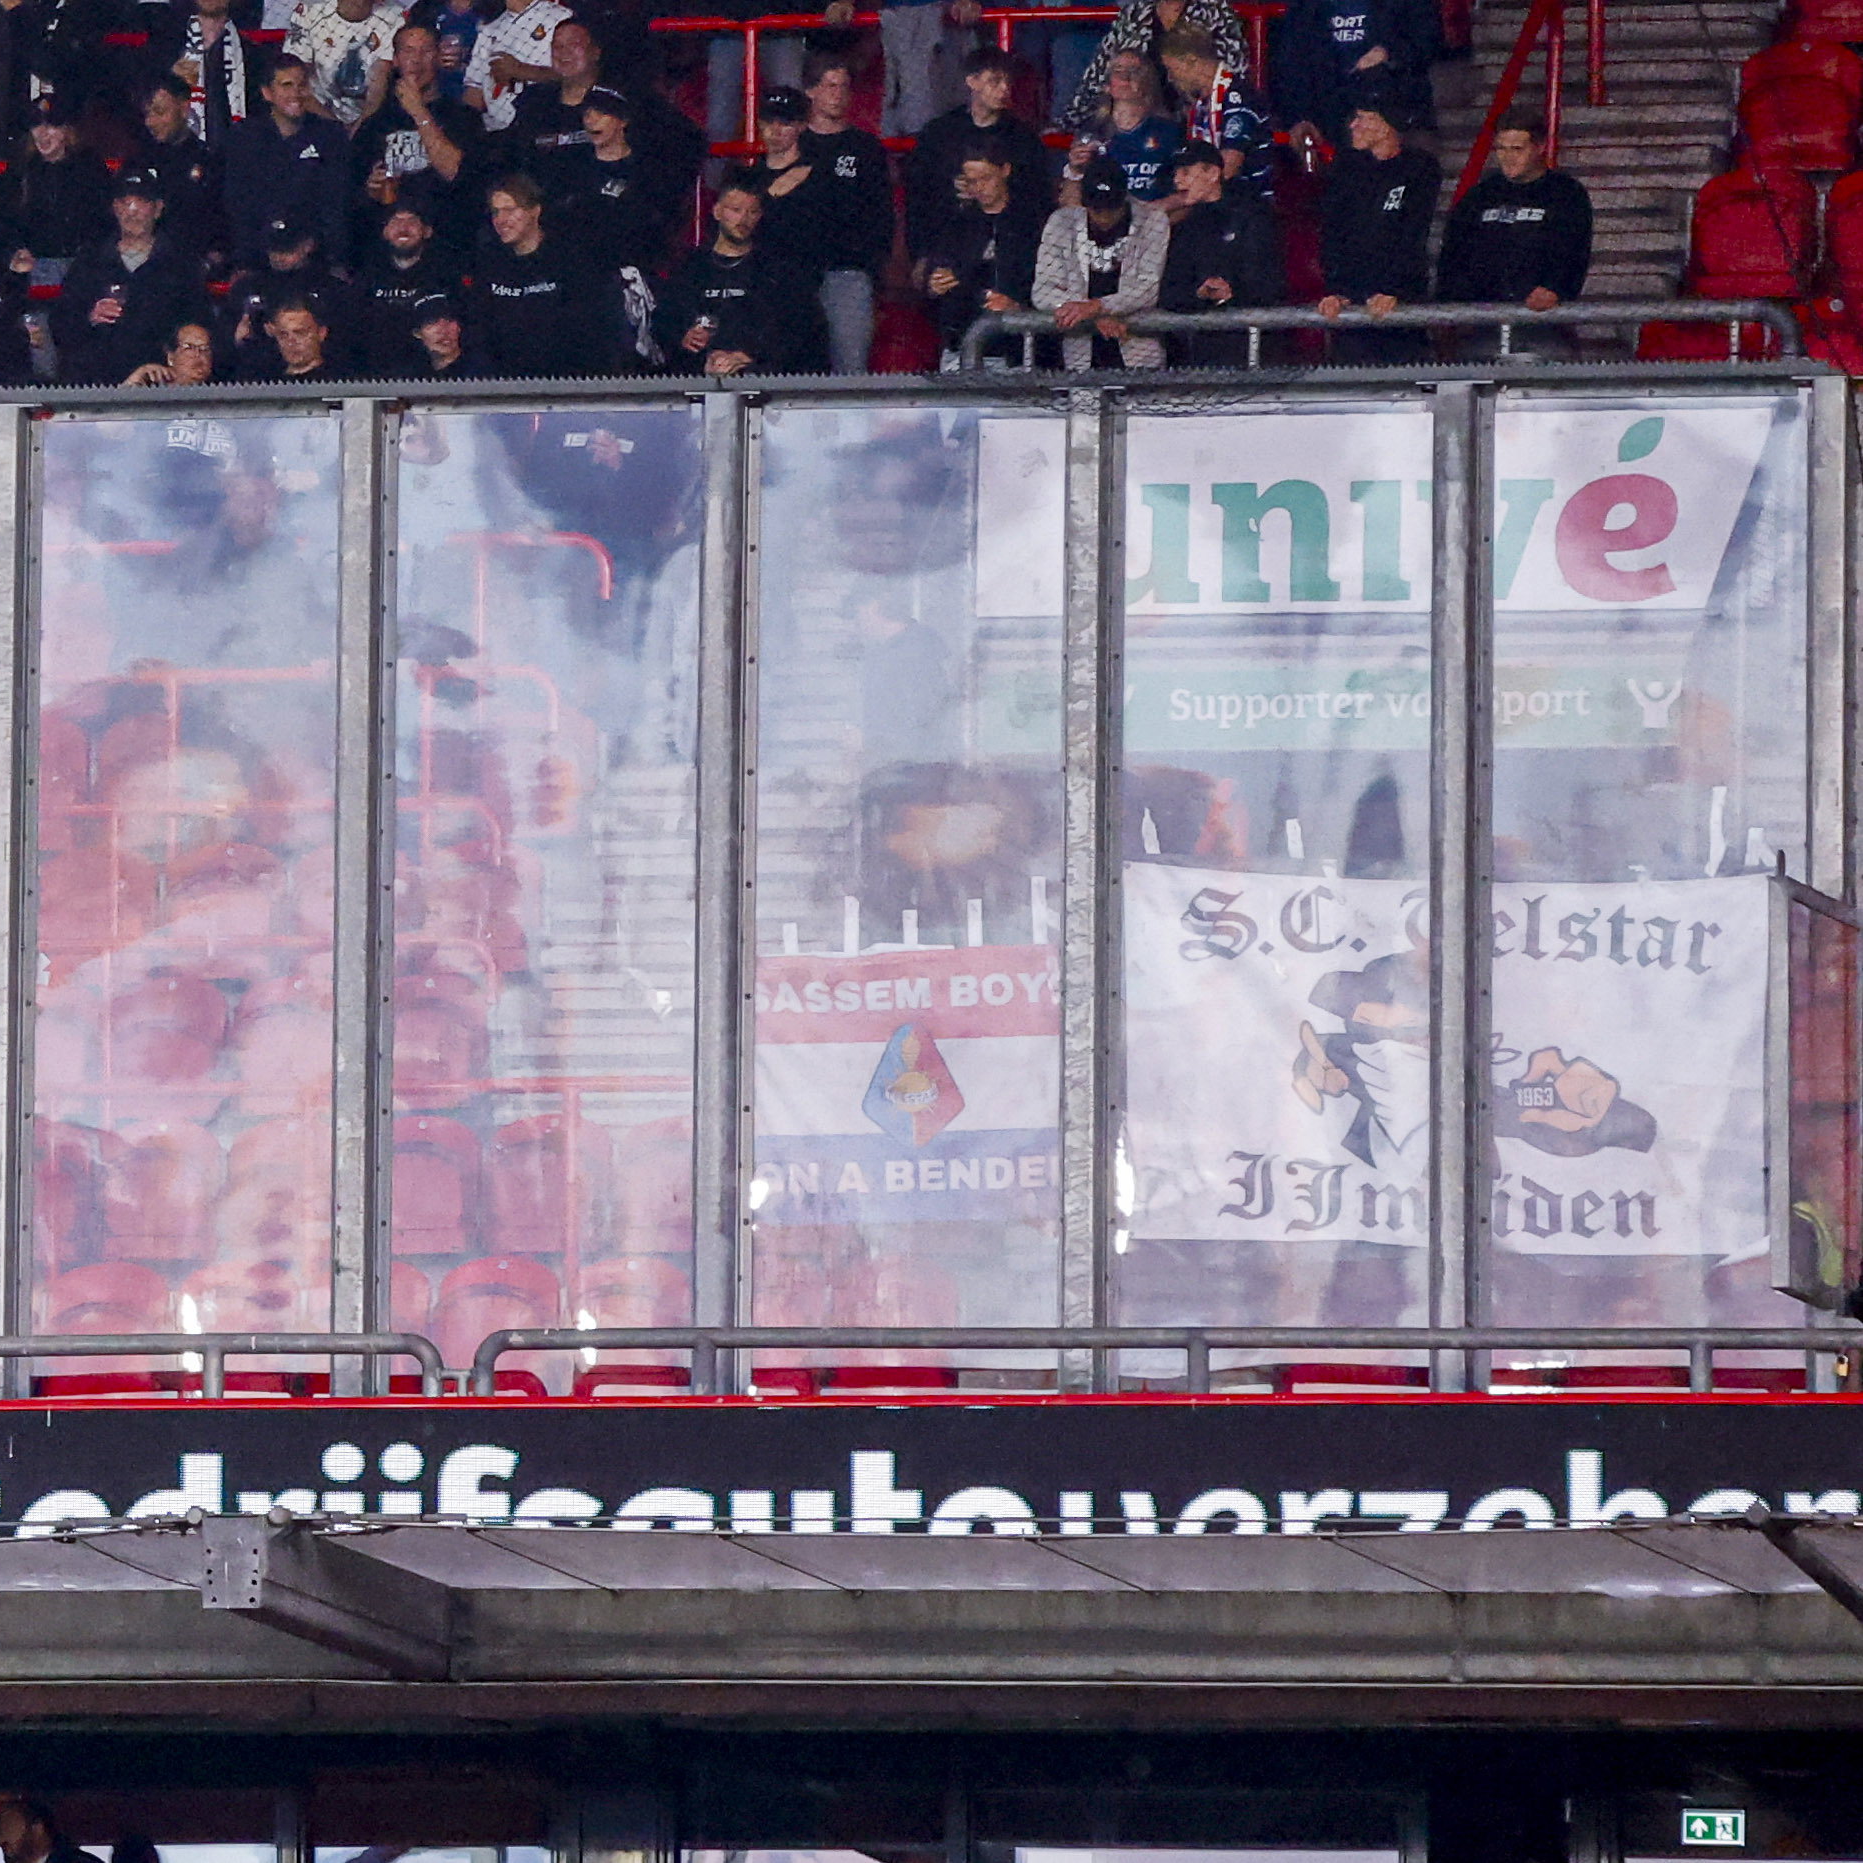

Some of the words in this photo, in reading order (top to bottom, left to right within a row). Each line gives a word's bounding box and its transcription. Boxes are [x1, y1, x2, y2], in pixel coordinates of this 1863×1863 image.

[1170, 687, 1374, 730] Supporter
[1180, 884, 1366, 962] S.C.
[1517, 1086, 1555, 1108] 1963
[836, 1161, 870, 1194] A
[1219, 1150, 1662, 1238] IJmiden
